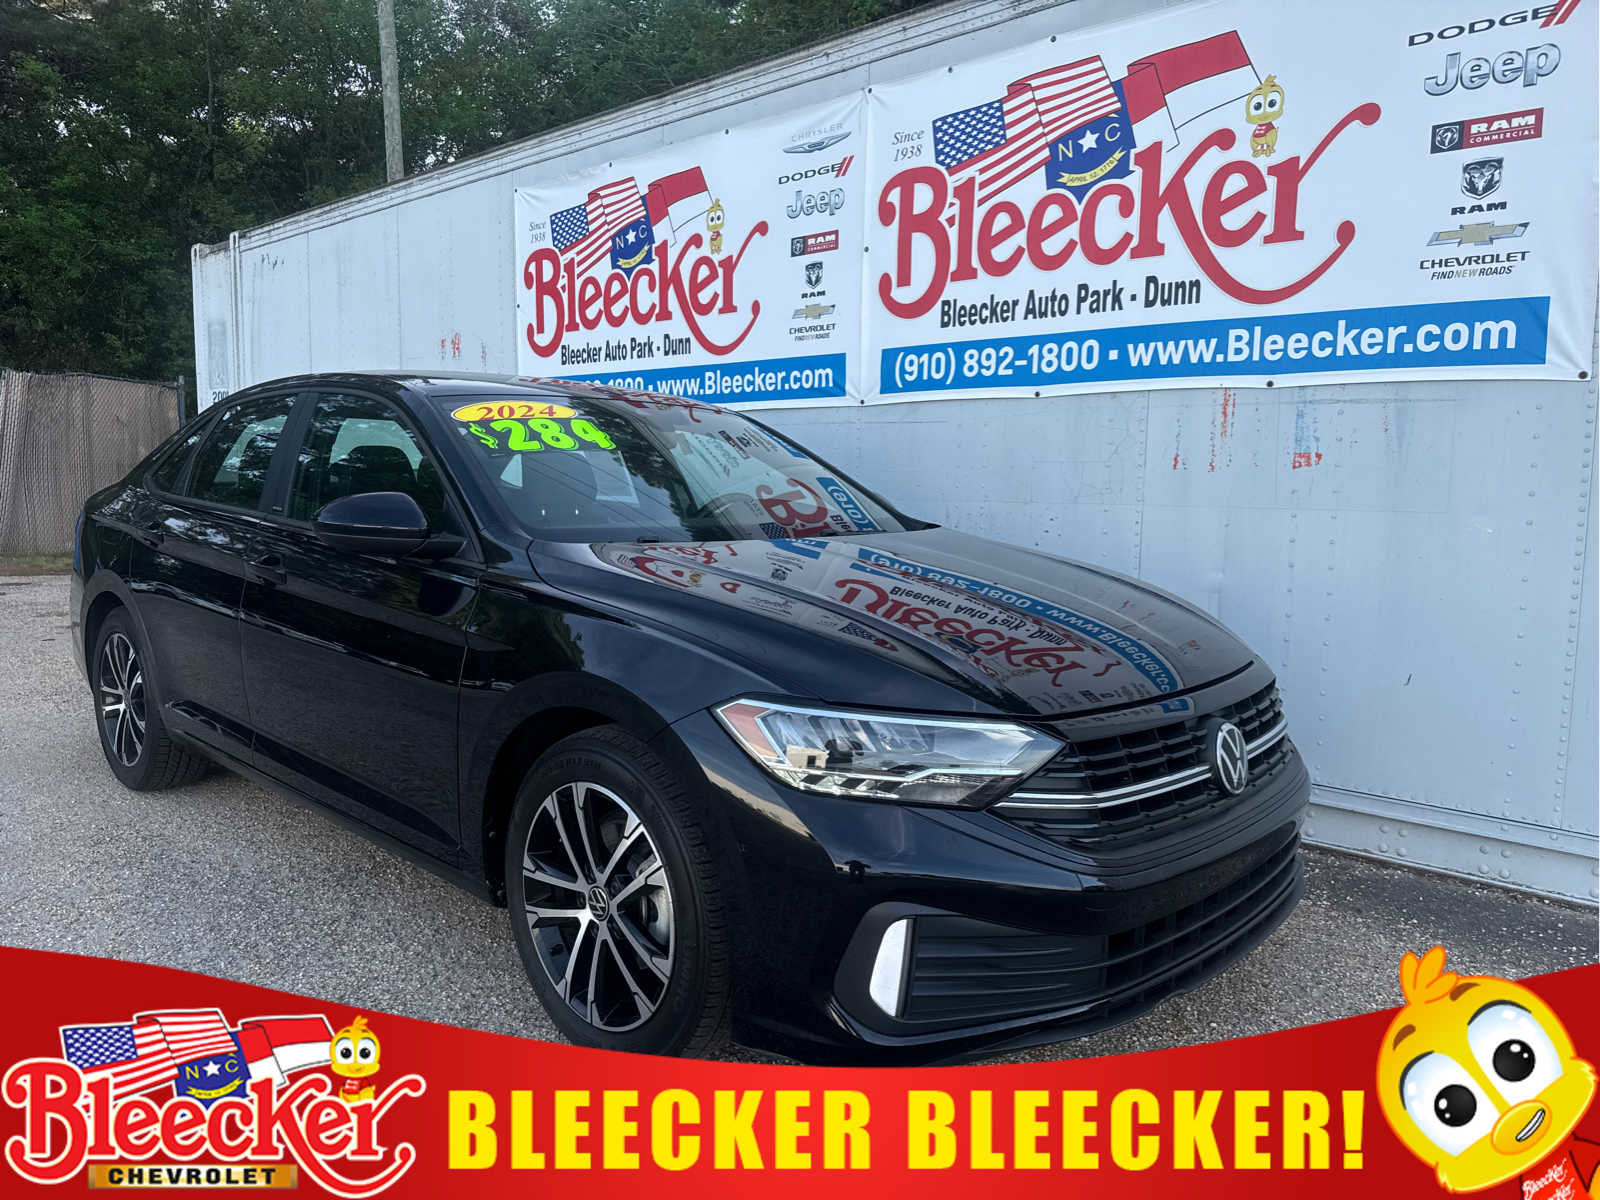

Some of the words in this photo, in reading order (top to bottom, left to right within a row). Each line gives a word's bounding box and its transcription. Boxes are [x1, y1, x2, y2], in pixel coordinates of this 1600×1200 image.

[1408, 4, 1559, 47] DODGE
[1424, 43, 1561, 96] Jeep
[1470, 113, 1536, 134] RAM
[892, 130, 925, 145] Since
[1058, 139, 1073, 161] N
[1104, 123, 1121, 142] C
[1470, 130, 1535, 144] COMMERCIAL
[893, 144, 923, 162] 1938
[779, 162, 842, 184] DODGE
[786, 188, 845, 219] Jeep
[878, 102, 1381, 319] Bleecker
[1451, 201, 1507, 216] RAM
[529, 221, 547, 232] Since
[530, 232, 547, 244] 1938
[808, 234, 836, 245] RAM
[1420, 250, 1531, 270] CHEVROLET
[524, 221, 769, 358] Bleecker
[801, 290, 826, 299] RAM
[940, 293, 1020, 328] Bleecker
[1023, 288, 1070, 321] Auto
[1076, 279, 1124, 313] Park
[1143, 274, 1201, 308] Dunn
[789, 323, 836, 335] CHEVROLET
[561, 340, 602, 366] Bleecker
[604, 339, 628, 363] Auto
[630, 335, 655, 360] Park
[663, 333, 692, 357] Dunn
[895, 347, 957, 388] (910)
[963, 338, 1100, 378] 892-1800
[1127, 319, 1517, 367] www.Bleecker.com
[656, 366, 834, 396] www.Bleecker.com
[477, 404, 557, 421] 2024
[468, 418, 617, 451] $284
